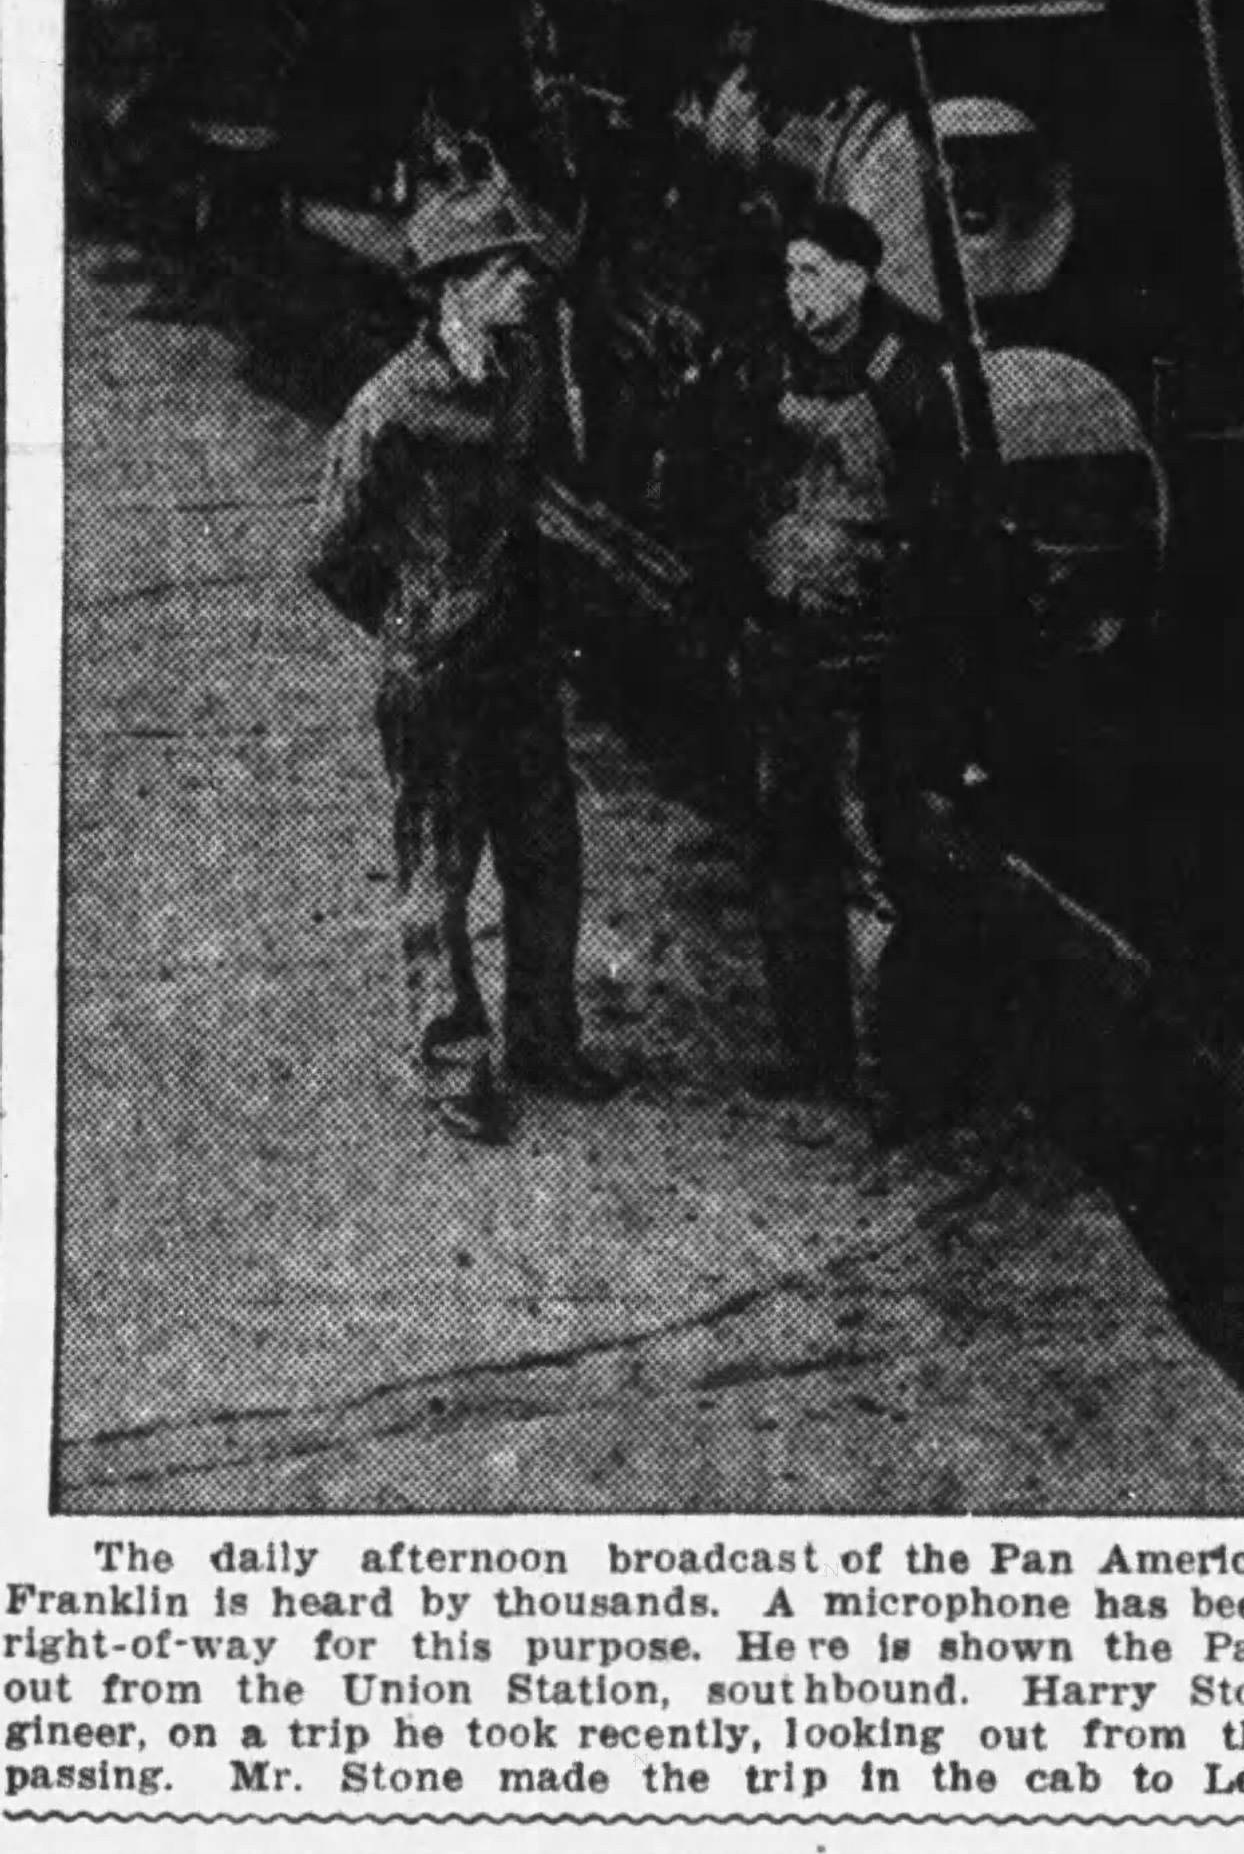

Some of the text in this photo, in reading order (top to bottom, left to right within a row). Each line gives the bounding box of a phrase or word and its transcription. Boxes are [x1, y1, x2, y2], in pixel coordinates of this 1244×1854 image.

[95, 1542, 172, 1572] The
[211, 1542, 317, 1576] daily
[362, 1542, 566, 1573] afternoon
[609, 1543, 816, 1573] broadcast
[842, 1543, 882, 1573] of
[907, 1544, 968, 1573] the
[992, 1543, 1072, 1574] Pan
[8, 1584, 187, 1616] Franklin
[216, 1588, 246, 1616] is
[274, 1588, 391, 1616] heard
[422, 1586, 469, 1620] by
[496, 1586, 717, 1617] thousands.
[766, 1588, 793, 1617] A
[825, 1587, 1068, 1622] microphone
[1096, 1589, 1167, 1618] has
[6, 1627, 275, 1665] right-of-way
[316, 1630, 375, 1660] for
[414, 1631, 490, 1659] this
[528, 1638, 699, 1666] purpose.
[739, 1631, 848, 1660] Here
[880, 1633, 909, 1662] is
[941, 1632, 1072, 1661] shown
[1106, 1632, 1170, 1661] the
[5, 1675, 70, 1702] out
[104, 1674, 200, 1703] from
[239, 1674, 302, 1703] the
[344, 1674, 469, 1704] Union
[509, 1674, 667, 1707] Station,
[709, 1673, 966, 1704] southbound.
[1025, 1676, 1155, 1710] Harry
[6, 1716, 144, 1750] gineer,
[170, 1724, 216, 1747] on
[242, 1725, 265, 1748] a
[290, 1719, 368, 1753] trip
[396, 1718, 442, 1747] he
[468, 1718, 555, 1747] took
[580, 1719, 760, 1753] recently,
[787, 1717, 943, 1753] looking
[981, 1724, 1045, 1750] out
[1085, 1719, 1184, 1748] from
[6, 1761, 171, 1795] passing.
[231, 1761, 300, 1790] Mr.
[342, 1763, 462, 1791] Stone
[501, 1762, 608, 1791] made
[644, 1762, 709, 1792] the
[746, 1762, 826, 1797] trip
[863, 1761, 898, 1791] in
[933, 1761, 996, 1792] the
[1026, 1762, 1099, 1792] cab
[1134, 1764, 1172, 1792] to
